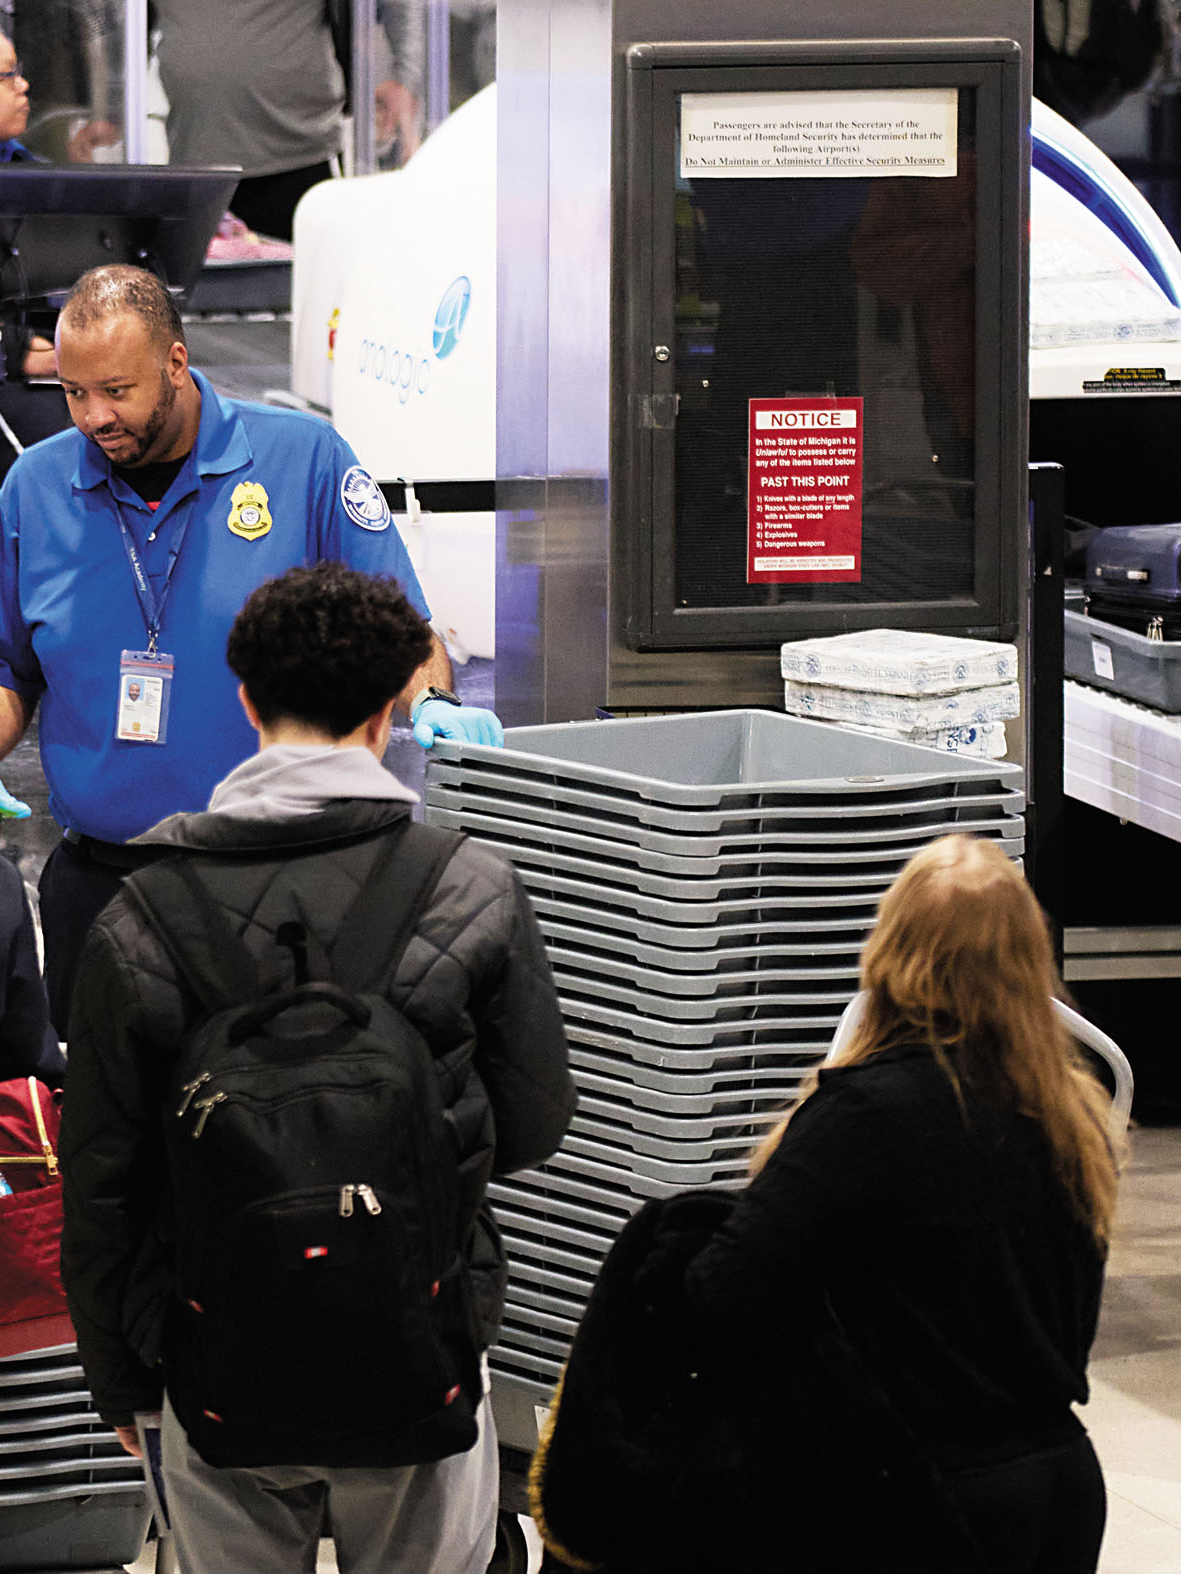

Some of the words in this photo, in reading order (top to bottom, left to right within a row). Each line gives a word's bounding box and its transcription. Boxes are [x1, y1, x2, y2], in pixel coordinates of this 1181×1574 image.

[713, 121, 761, 130] Passengers
[779, 120, 812, 129] advised
[815, 120, 833, 129] that
[835, 120, 849, 129] the
[851, 120, 892, 130] Secretary
[895, 120, 905, 128] of
[906, 120, 920, 128] the
[688, 133, 740, 143] Department
[743, 133, 753, 141] of
[755, 132, 800, 141] Homeland
[802, 132, 838, 142] Security
[841, 132, 856, 140] has
[858, 132, 908, 140] determined
[910, 132, 927, 140] that
[930, 132, 943, 140] the
[773, 145, 813, 154] following
[816, 145, 860, 154] Airport(s)
[685, 157, 698, 166] Do
[700, 157, 716, 166] Not
[719, 156, 759, 166] Maintain
[774, 156, 822, 166] Administer
[825, 156, 864, 166] Effective
[866, 156, 901, 166] Security
[905, 156, 946, 165] Measures
[771, 412, 842, 426] NOTICE
[756, 438, 762, 446] In
[764, 438, 776, 446] the
[778, 438, 798, 446] State
[808, 437, 841, 446] Michigan
[842, 437, 848, 445] it
[849, 436, 856, 445] is
[756, 448, 788, 456] Unlawful
[789, 448, 797, 456] to
[798, 448, 827, 457] possess
[838, 448, 856, 456] carry
[756, 460, 768, 468] any
[770, 459, 778, 467] of
[779, 458, 790, 466] the
[792, 458, 812, 466] items
[813, 458, 834, 466] listed
[761, 476, 789, 487] PAST
[790, 476, 815, 487] THIS
[817, 475, 850, 486] POINT
[836, 494, 855, 502] length
[764, 541, 797, 549] Dangerous
[798, 540, 826, 548] weapons
